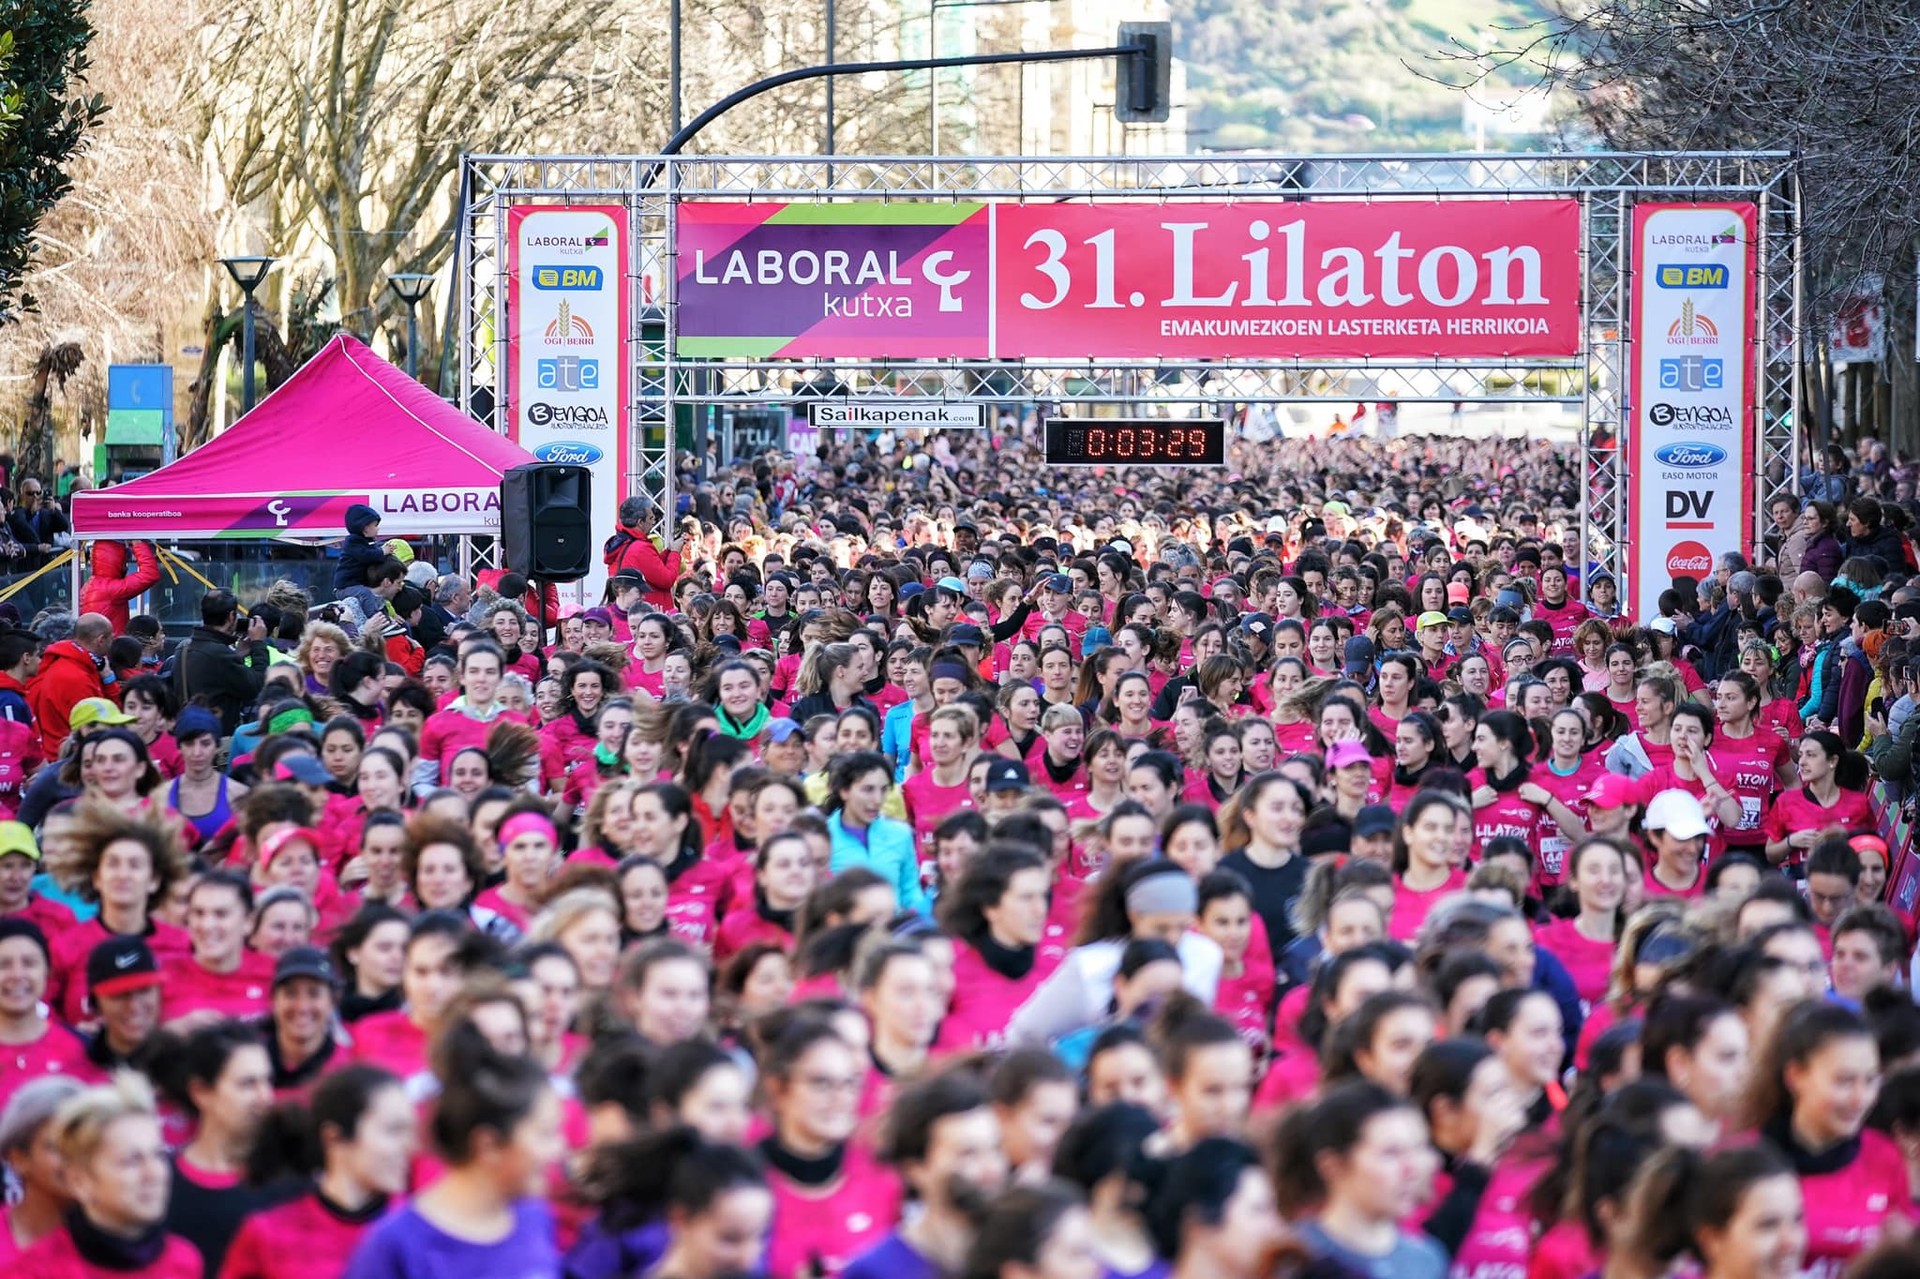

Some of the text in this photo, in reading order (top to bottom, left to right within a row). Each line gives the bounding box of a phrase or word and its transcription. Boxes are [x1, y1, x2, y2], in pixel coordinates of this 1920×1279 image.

[527, 236, 583, 246] LABORAL
[1652, 234, 1710, 245] LABORAL
[559, 247, 584, 255] kutxa
[695, 249, 912, 285] LABORAL
[1020, 219, 1550, 310] 31. Lilaton
[562, 269, 597, 287] BM
[1686, 267, 1724, 286] BM
[823, 291, 912, 317] kutxa
[1160, 317, 1550, 337] EMAKUMEZKOEN LASTERKETA HERRIKOIA
[544, 338, 594, 346] OGI BERRI
[1667, 337, 1719, 345] OGI BERRI
[539, 358, 597, 389] ate
[1661, 358, 1722, 390] ate
[820, 406, 974, 424] Sailkapenak.com
[1087, 429, 1206, 457] 0:03:29
[546, 445, 590, 463] Ford
[1668, 446, 1713, 464] Ford
[1662, 472, 1718, 480] EASO MOTOR
[383, 492, 501, 513] LABORA
[1665, 490, 1715, 519] DV
[107, 510, 182, 519] banka kooperatiboa
[1475, 823, 1530, 839] LILATON
